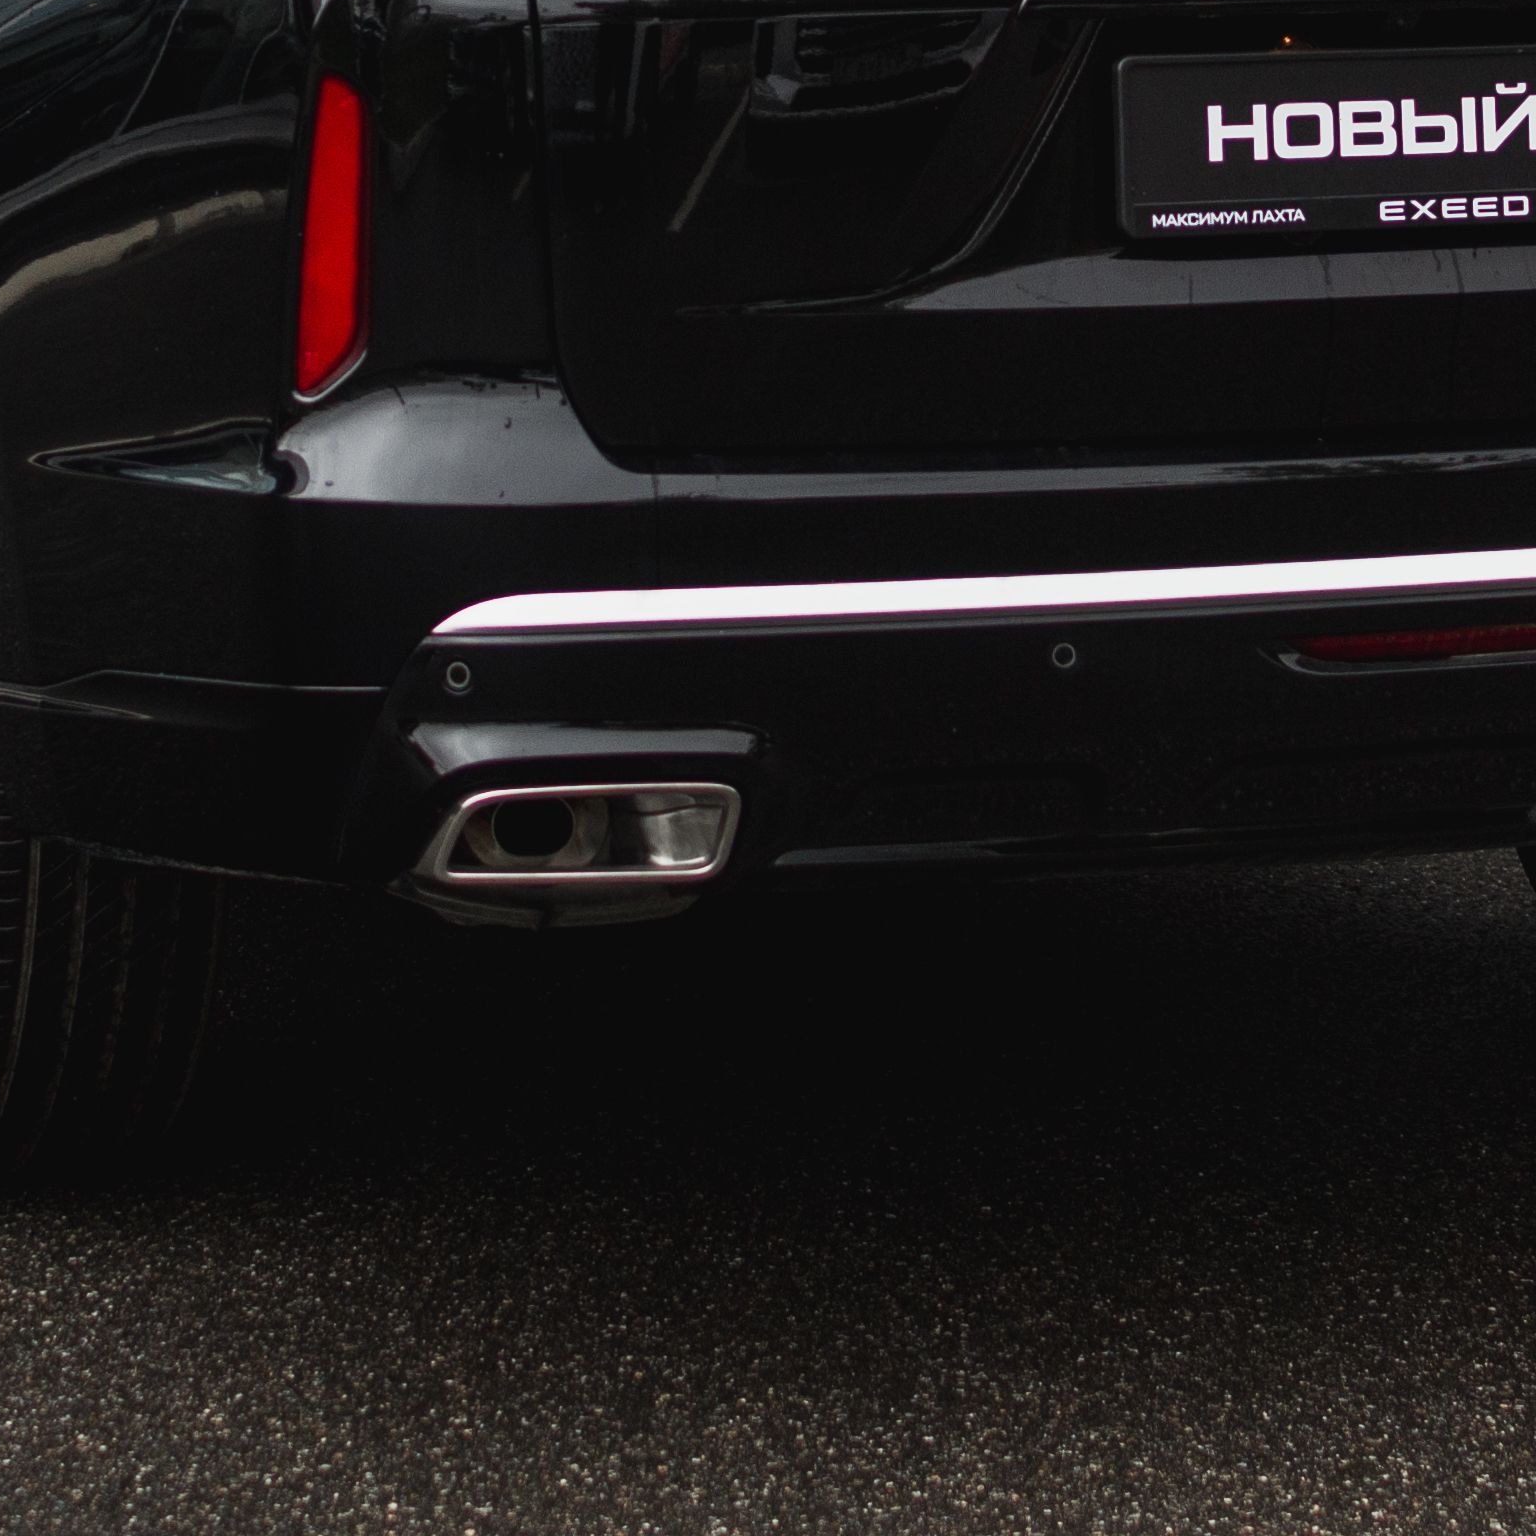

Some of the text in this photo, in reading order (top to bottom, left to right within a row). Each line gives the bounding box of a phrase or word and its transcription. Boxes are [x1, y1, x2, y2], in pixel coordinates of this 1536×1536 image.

[1151, 207, 1306, 228] МАКСИМУМ ЛАХТА
[1379, 195, 1531, 222] EXEED
